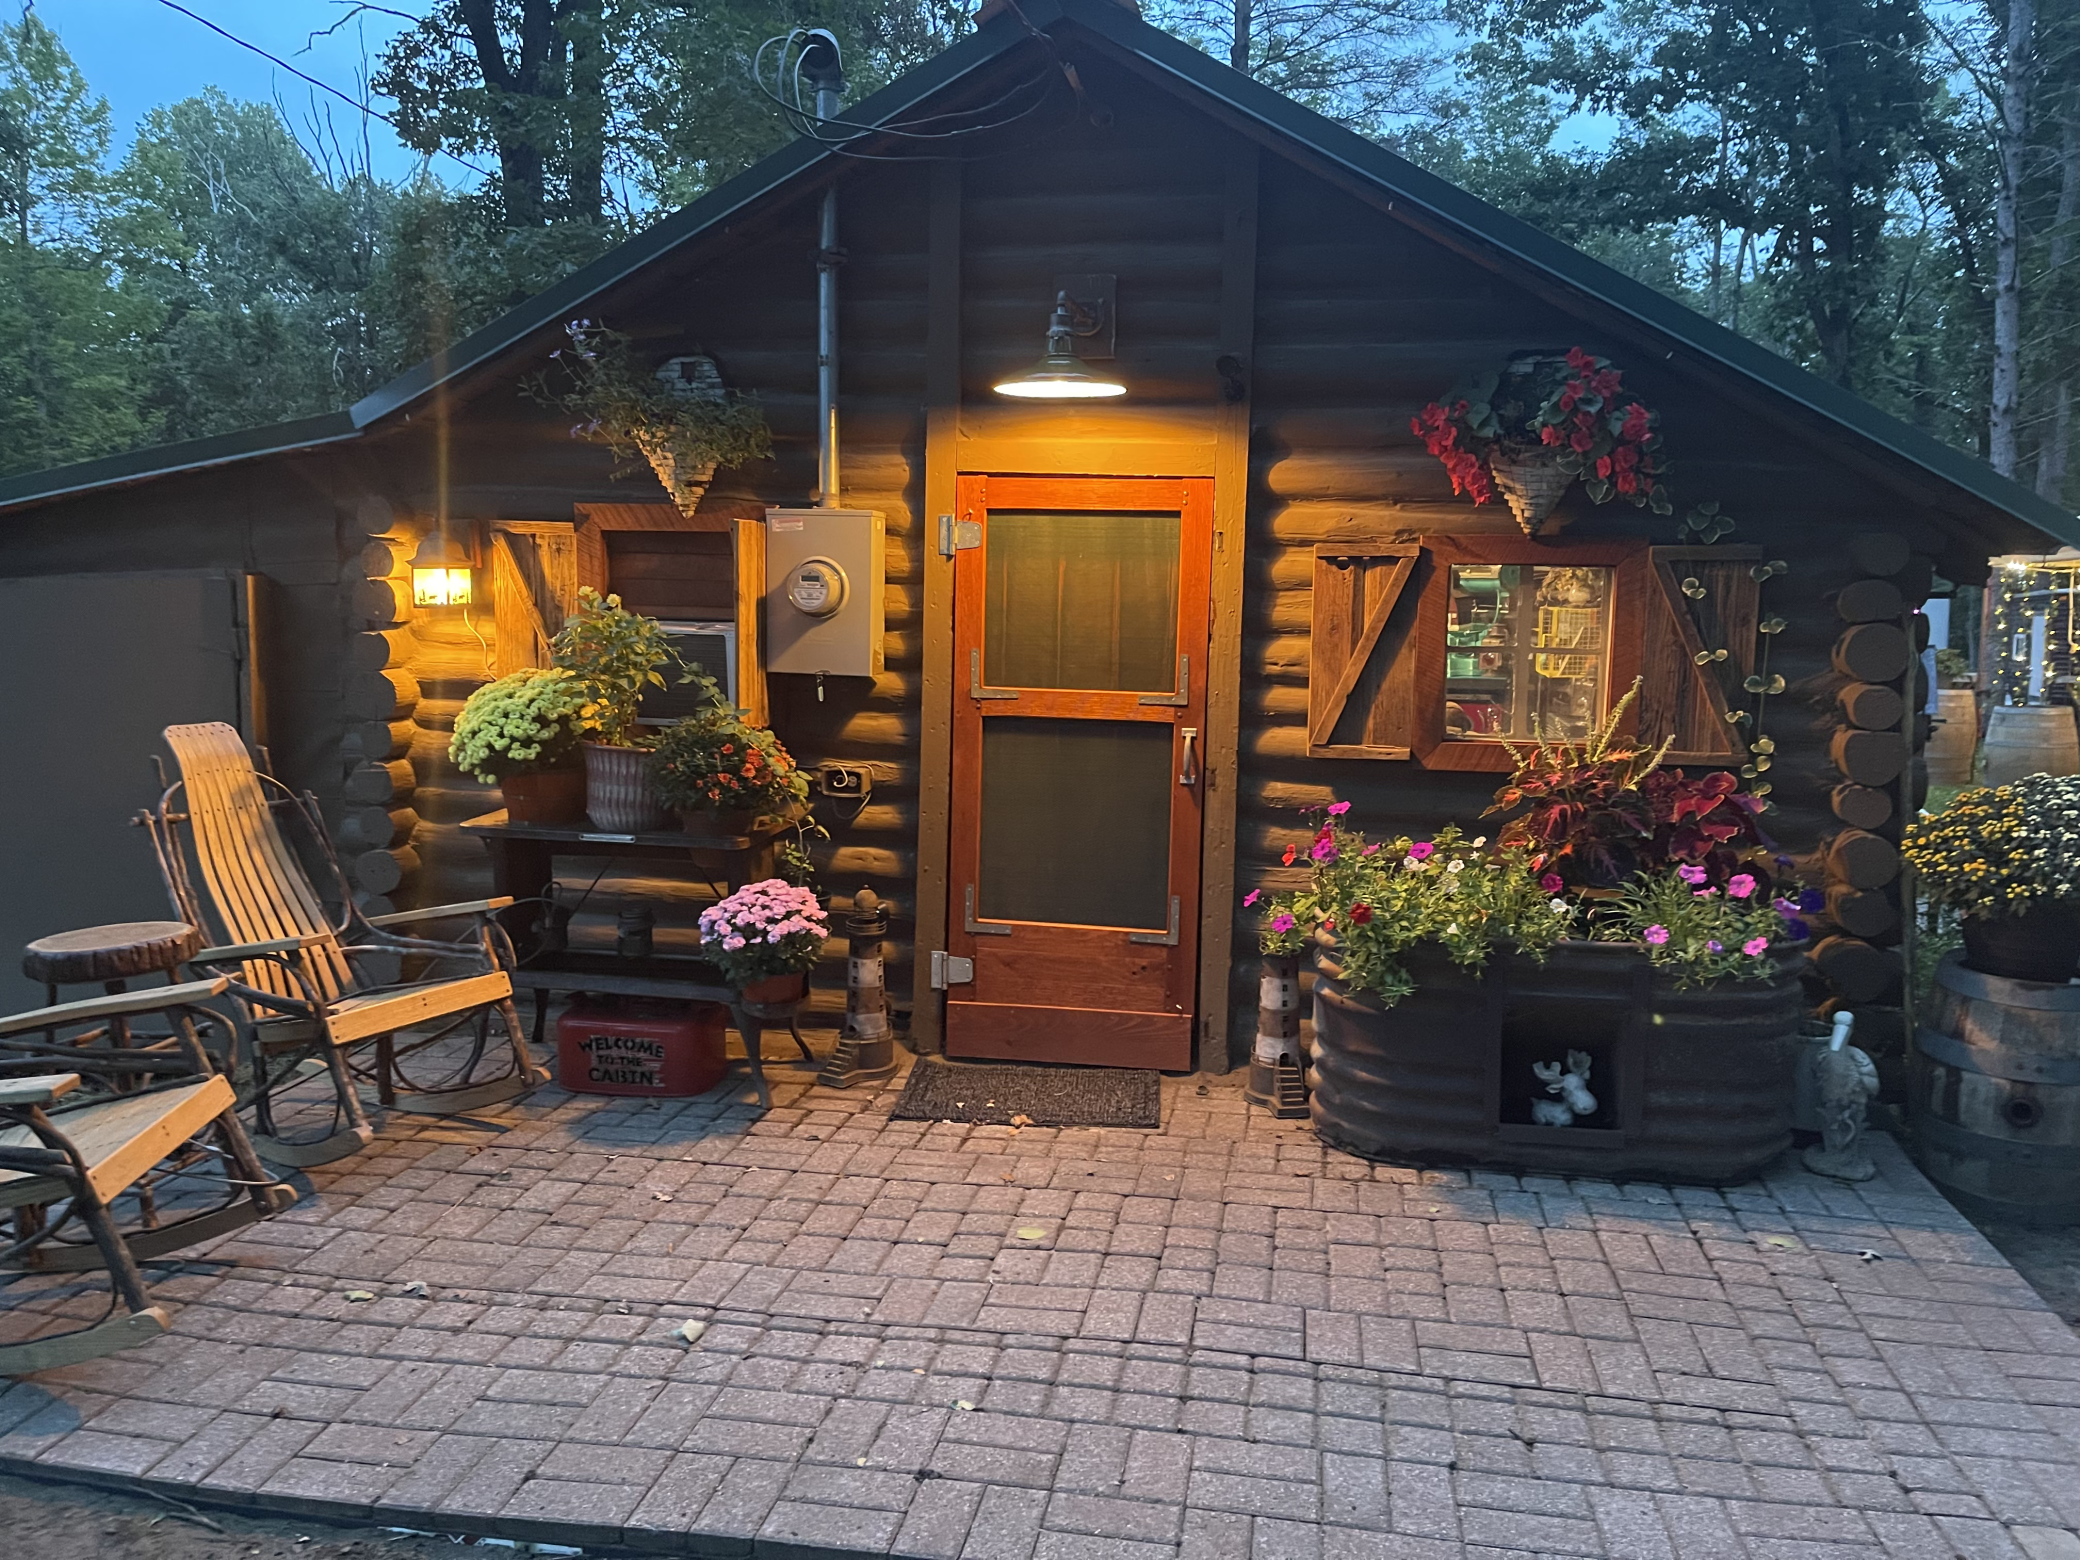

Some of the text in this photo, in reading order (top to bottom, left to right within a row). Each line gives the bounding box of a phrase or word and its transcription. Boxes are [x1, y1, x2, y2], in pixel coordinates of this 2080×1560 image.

[578, 1036, 665, 1058] WELCOME
[597, 1055, 643, 1066] TO THE
[589, 1067, 654, 1086] CABIN
